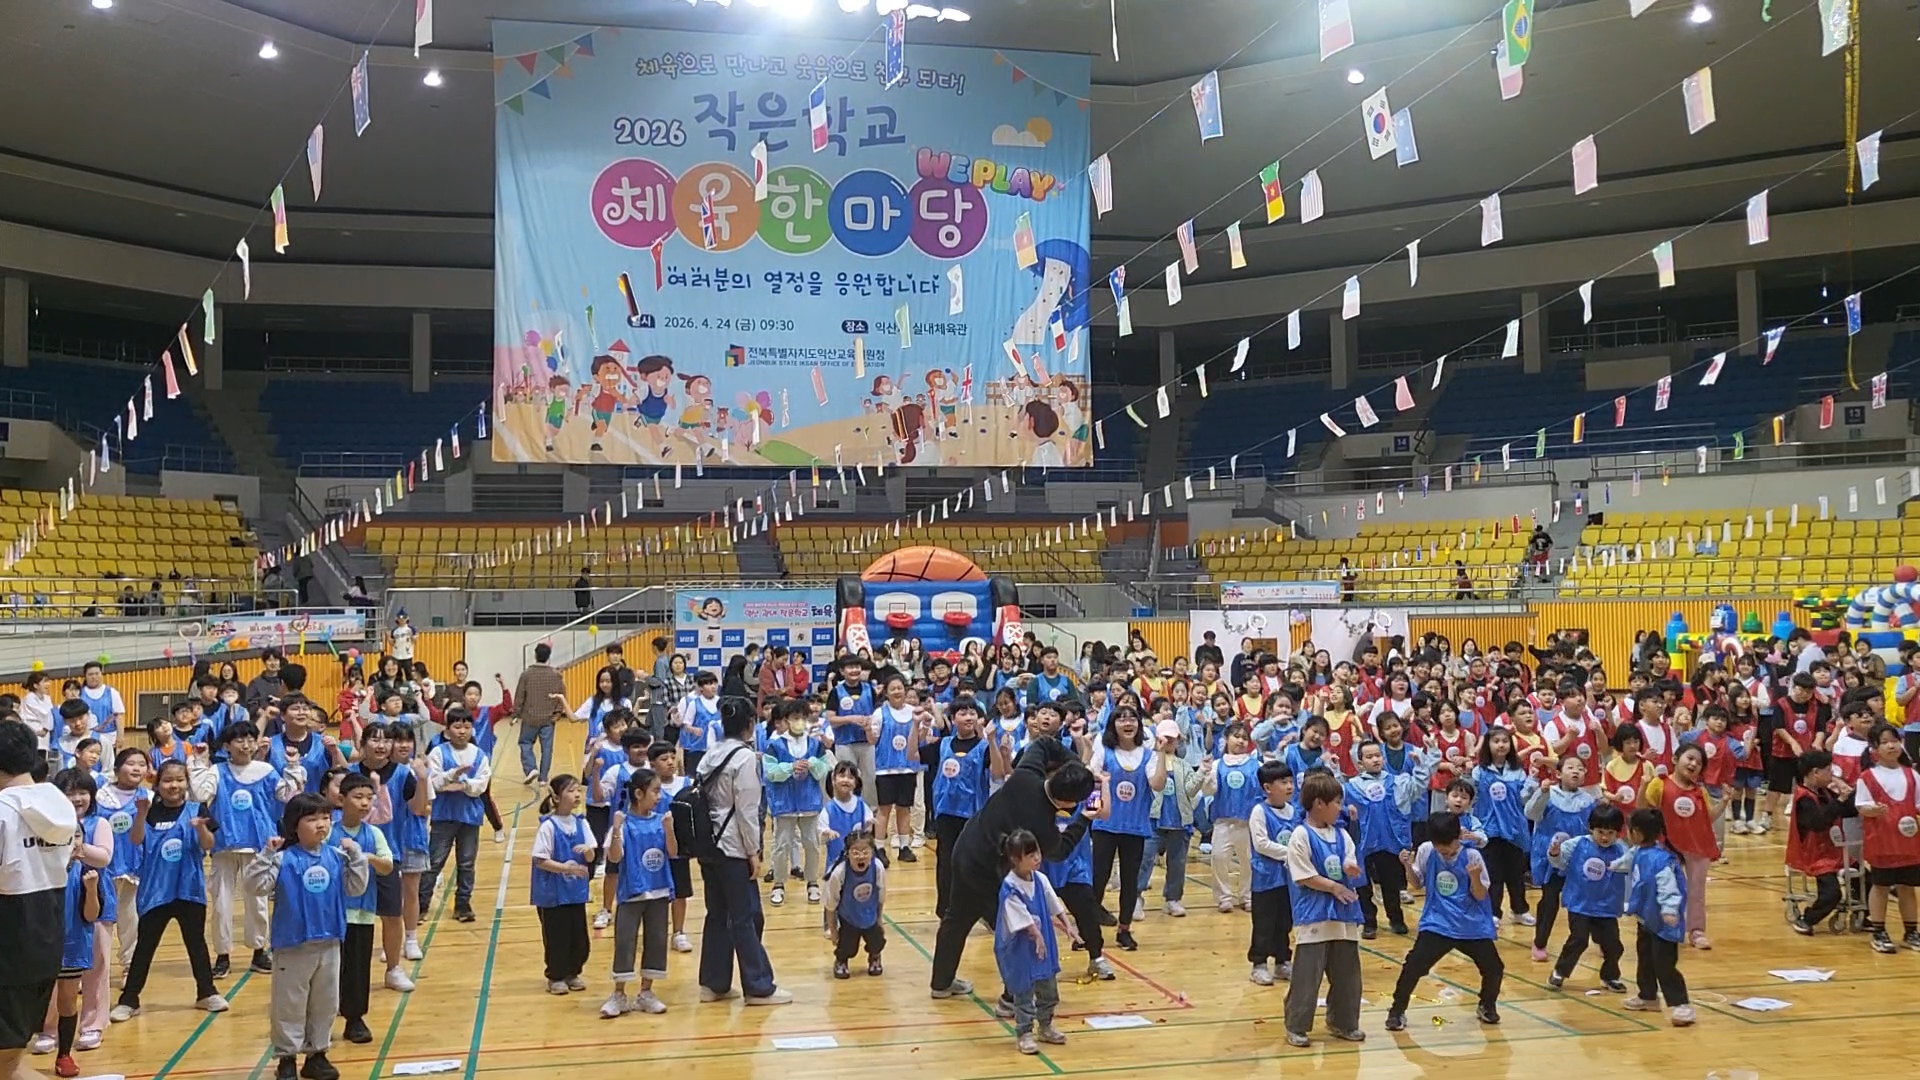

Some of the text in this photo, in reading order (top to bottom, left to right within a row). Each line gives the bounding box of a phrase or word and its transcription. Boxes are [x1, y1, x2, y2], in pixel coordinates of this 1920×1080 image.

[636, 52, 718, 80] 체육으로
[725, 54, 787, 77] 만나고
[795, 54, 868, 81] 웃음으로
[917, 68, 965, 96] 되다!
[614, 117, 687, 147] 2026
[917, 147, 1056, 202] WE PLAY
[667, 266, 940, 297] 여러분의 열정을 응원합니다
[664, 316, 795, 332] 2026. 4. 24 (금) 09:30
[845, 320, 867, 333] 장소
[875, 321, 968, 336] 익산 실내체육관
[748, 346, 885, 361] 전북특별자치도익산교육원청
